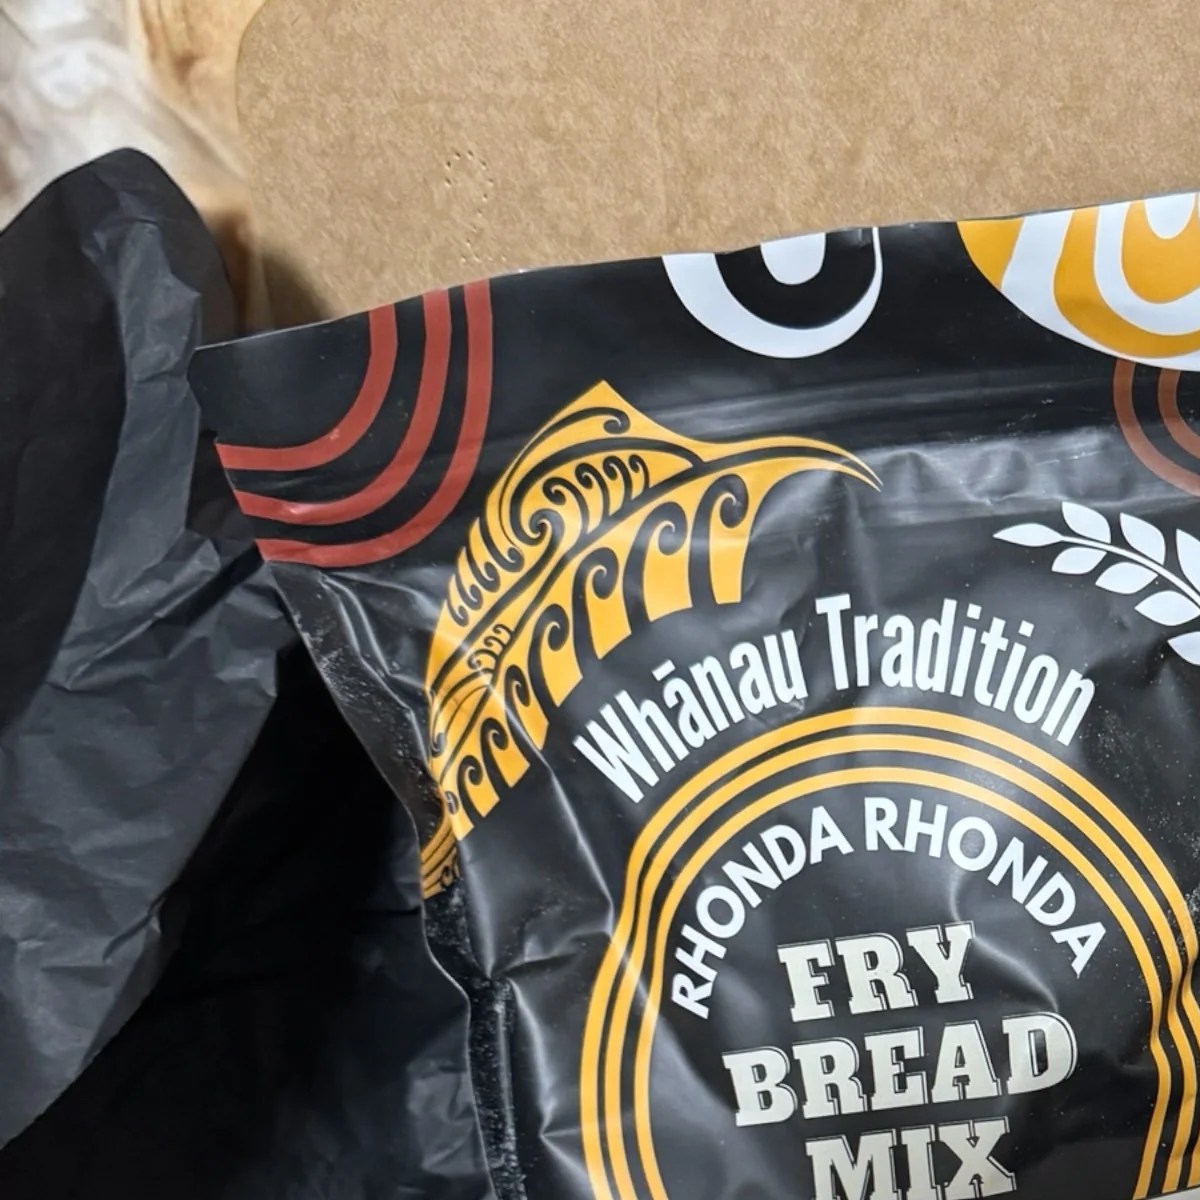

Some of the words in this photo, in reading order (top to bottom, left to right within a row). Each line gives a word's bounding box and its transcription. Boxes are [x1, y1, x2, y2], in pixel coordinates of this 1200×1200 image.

[573, 627, 806, 803] Whānau
[815, 593, 1096, 747] Tradition
[671, 805, 853, 1019] RHONDA
[863, 796, 1108, 977] RHONDA
[776, 920, 977, 1023] FRY
[722, 1011, 1079, 1127] BREAD
